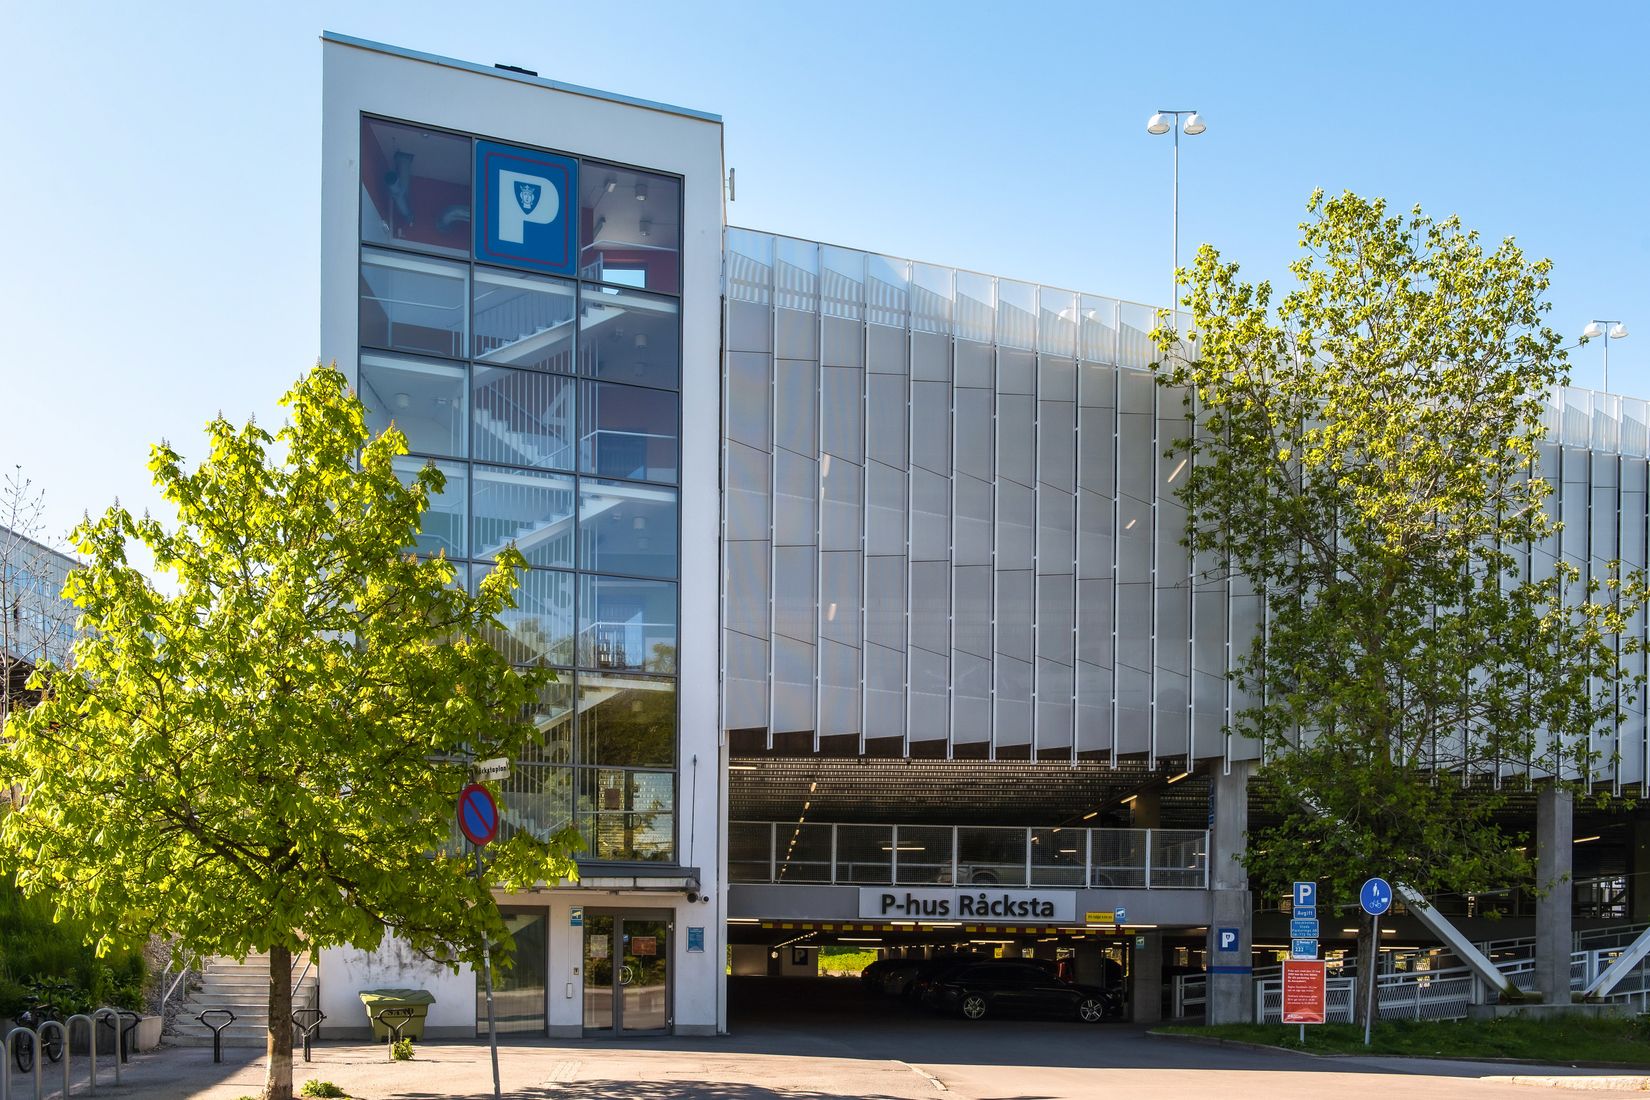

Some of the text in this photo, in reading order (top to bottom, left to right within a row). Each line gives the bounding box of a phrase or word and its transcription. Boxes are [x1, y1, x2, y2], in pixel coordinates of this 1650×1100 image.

[498, 169, 560, 244] P
[881, 893, 1054, 917] P-hus Råcksta
[1299, 884, 1312, 904] P
[1222, 932, 1235, 948] P
